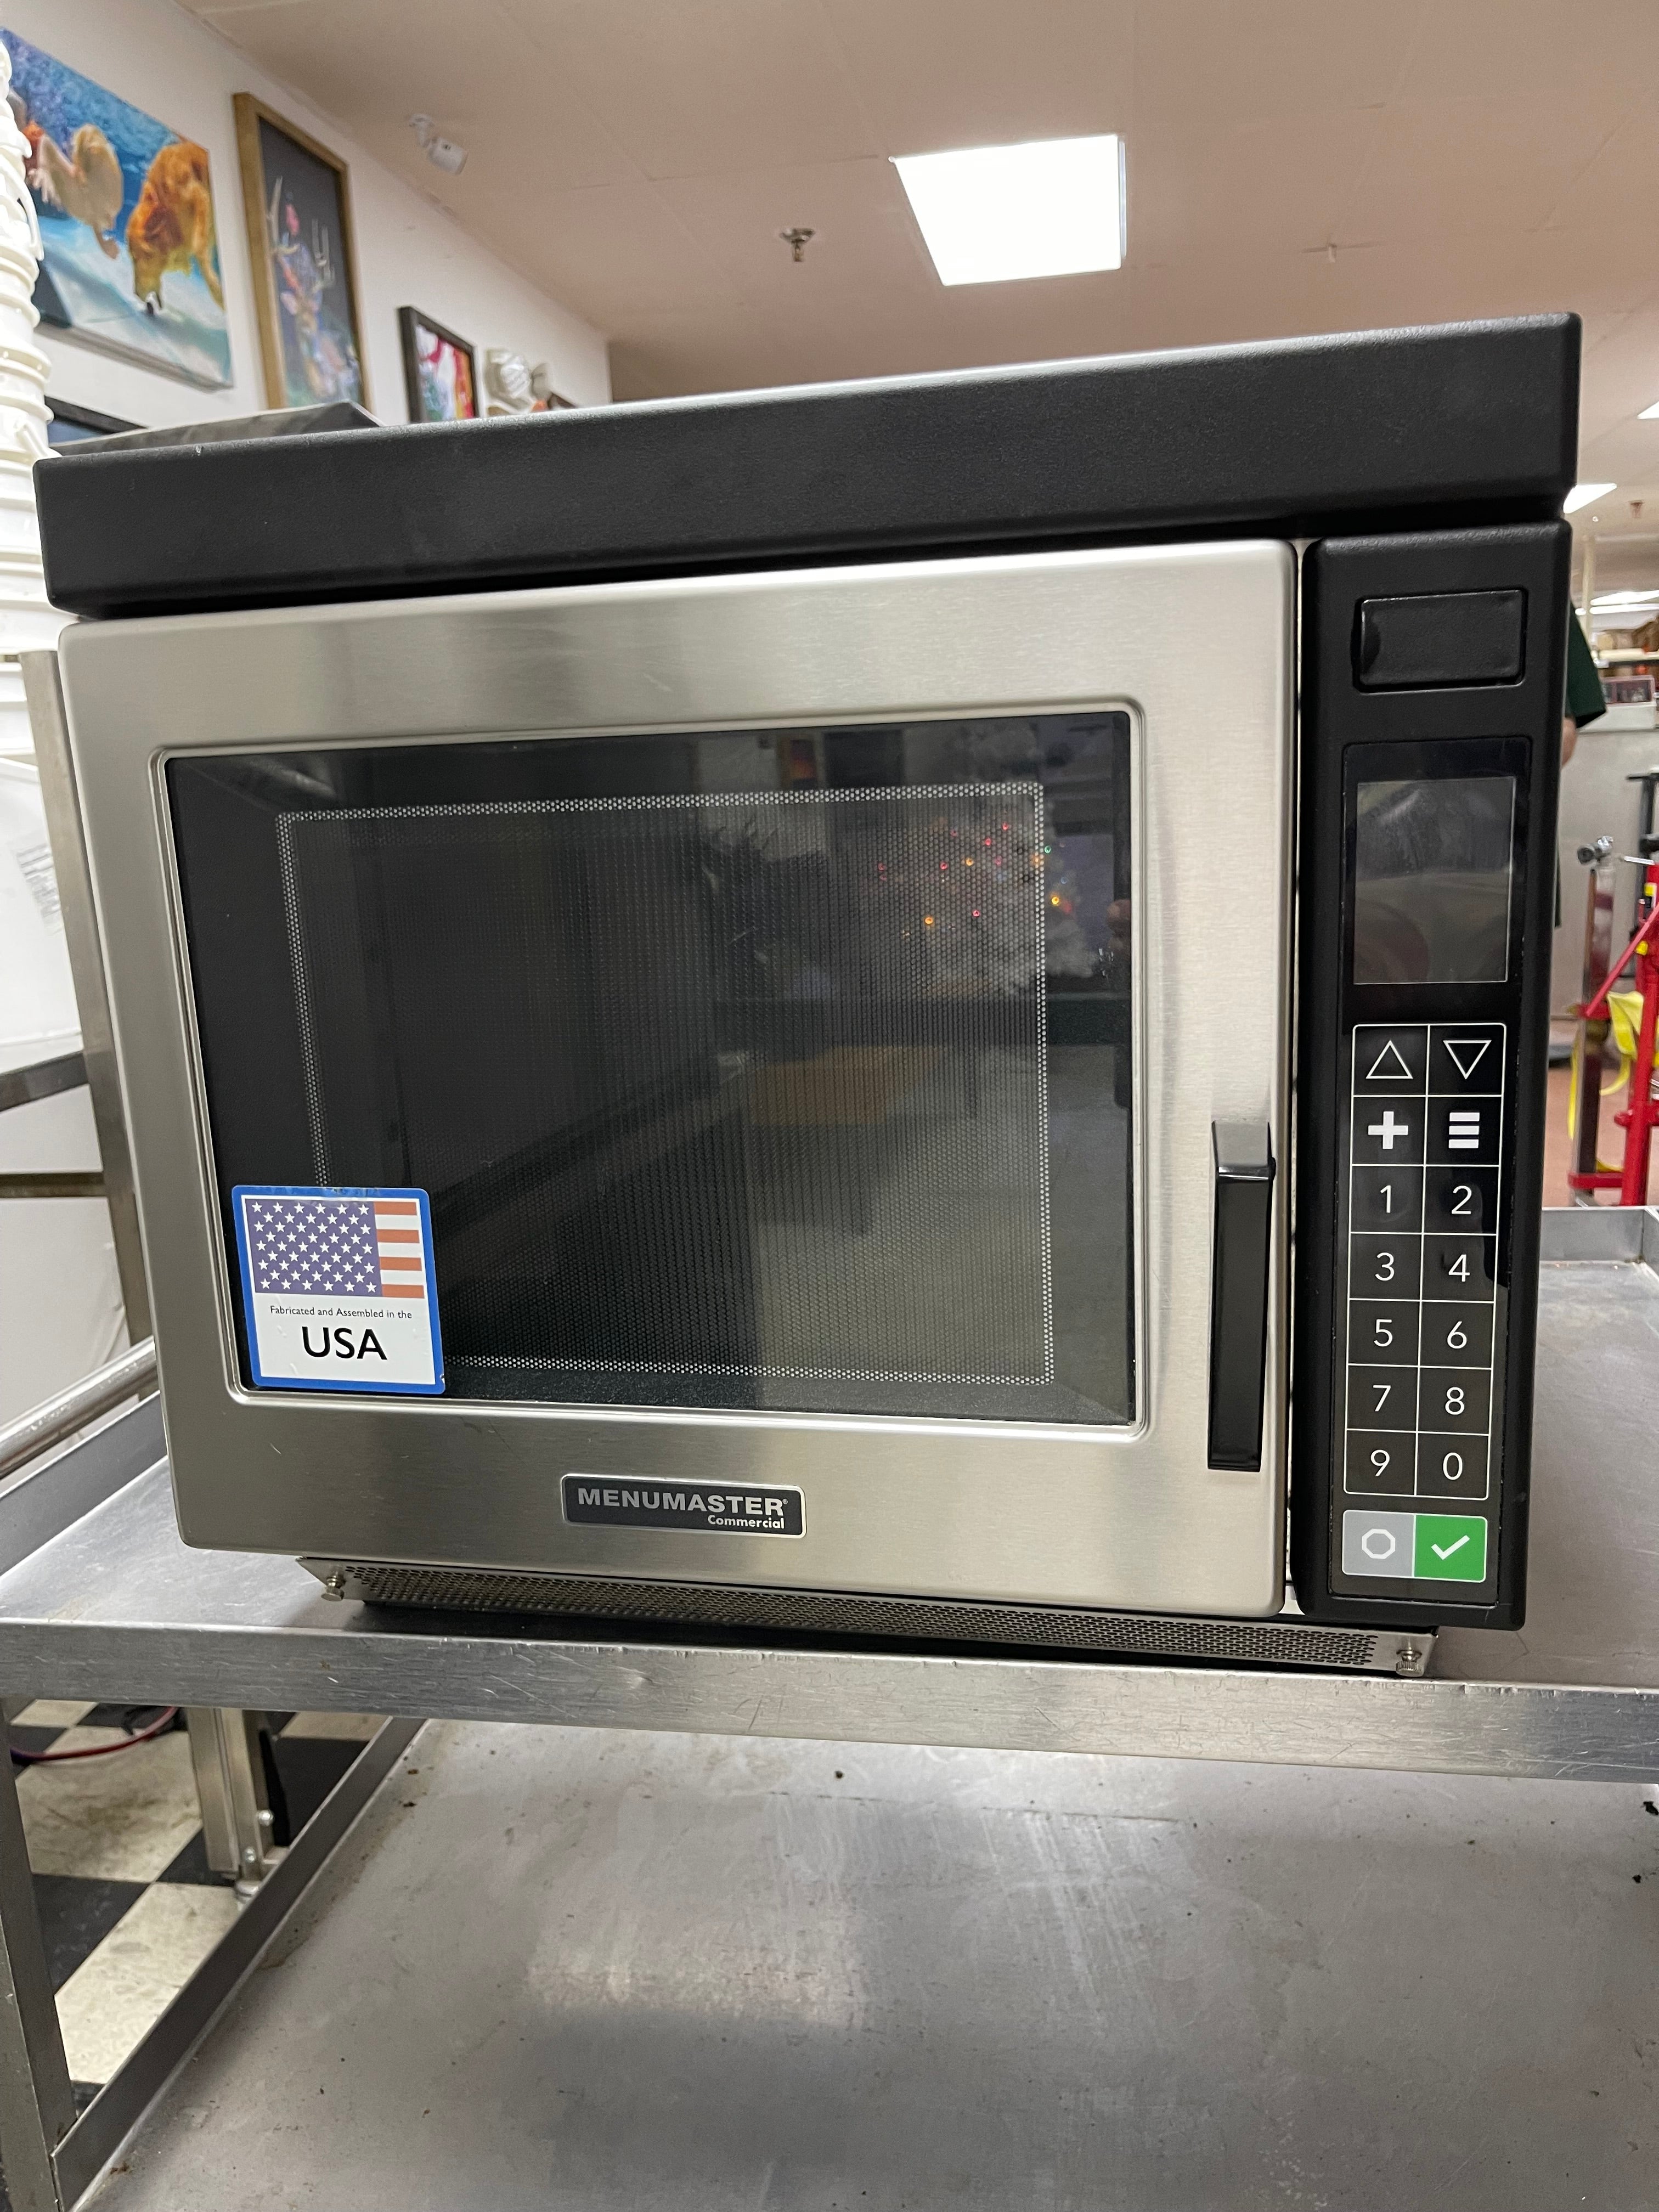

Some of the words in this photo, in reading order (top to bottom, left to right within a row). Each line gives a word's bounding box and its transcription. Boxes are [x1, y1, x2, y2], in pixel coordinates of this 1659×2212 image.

[1380, 1184, 1391, 1214] 1
[1451, 1185, 1472, 1215] 2
[1375, 1252, 1395, 1281] 3
[1448, 1254, 1470, 1282] 4
[270, 1305, 315, 1316] Fabricated
[318, 1308, 333, 1316] and
[336, 1308, 384, 1318] Assembled
[387, 1310, 394, 1318] in
[398, 1311, 413, 1319] the
[302, 1326, 388, 1361] USA
[1374, 1318, 1393, 1347] 5
[1447, 1321, 1467, 1349] 6
[1373, 1384, 1391, 1412] 7
[1444, 1386, 1465, 1415] 8
[1370, 1449, 1390, 1477] 9
[1442, 1452, 1463, 1480] 0
[578, 1487, 784, 1516] MENUMASTER
[707, 1514, 785, 1530] Commercial
